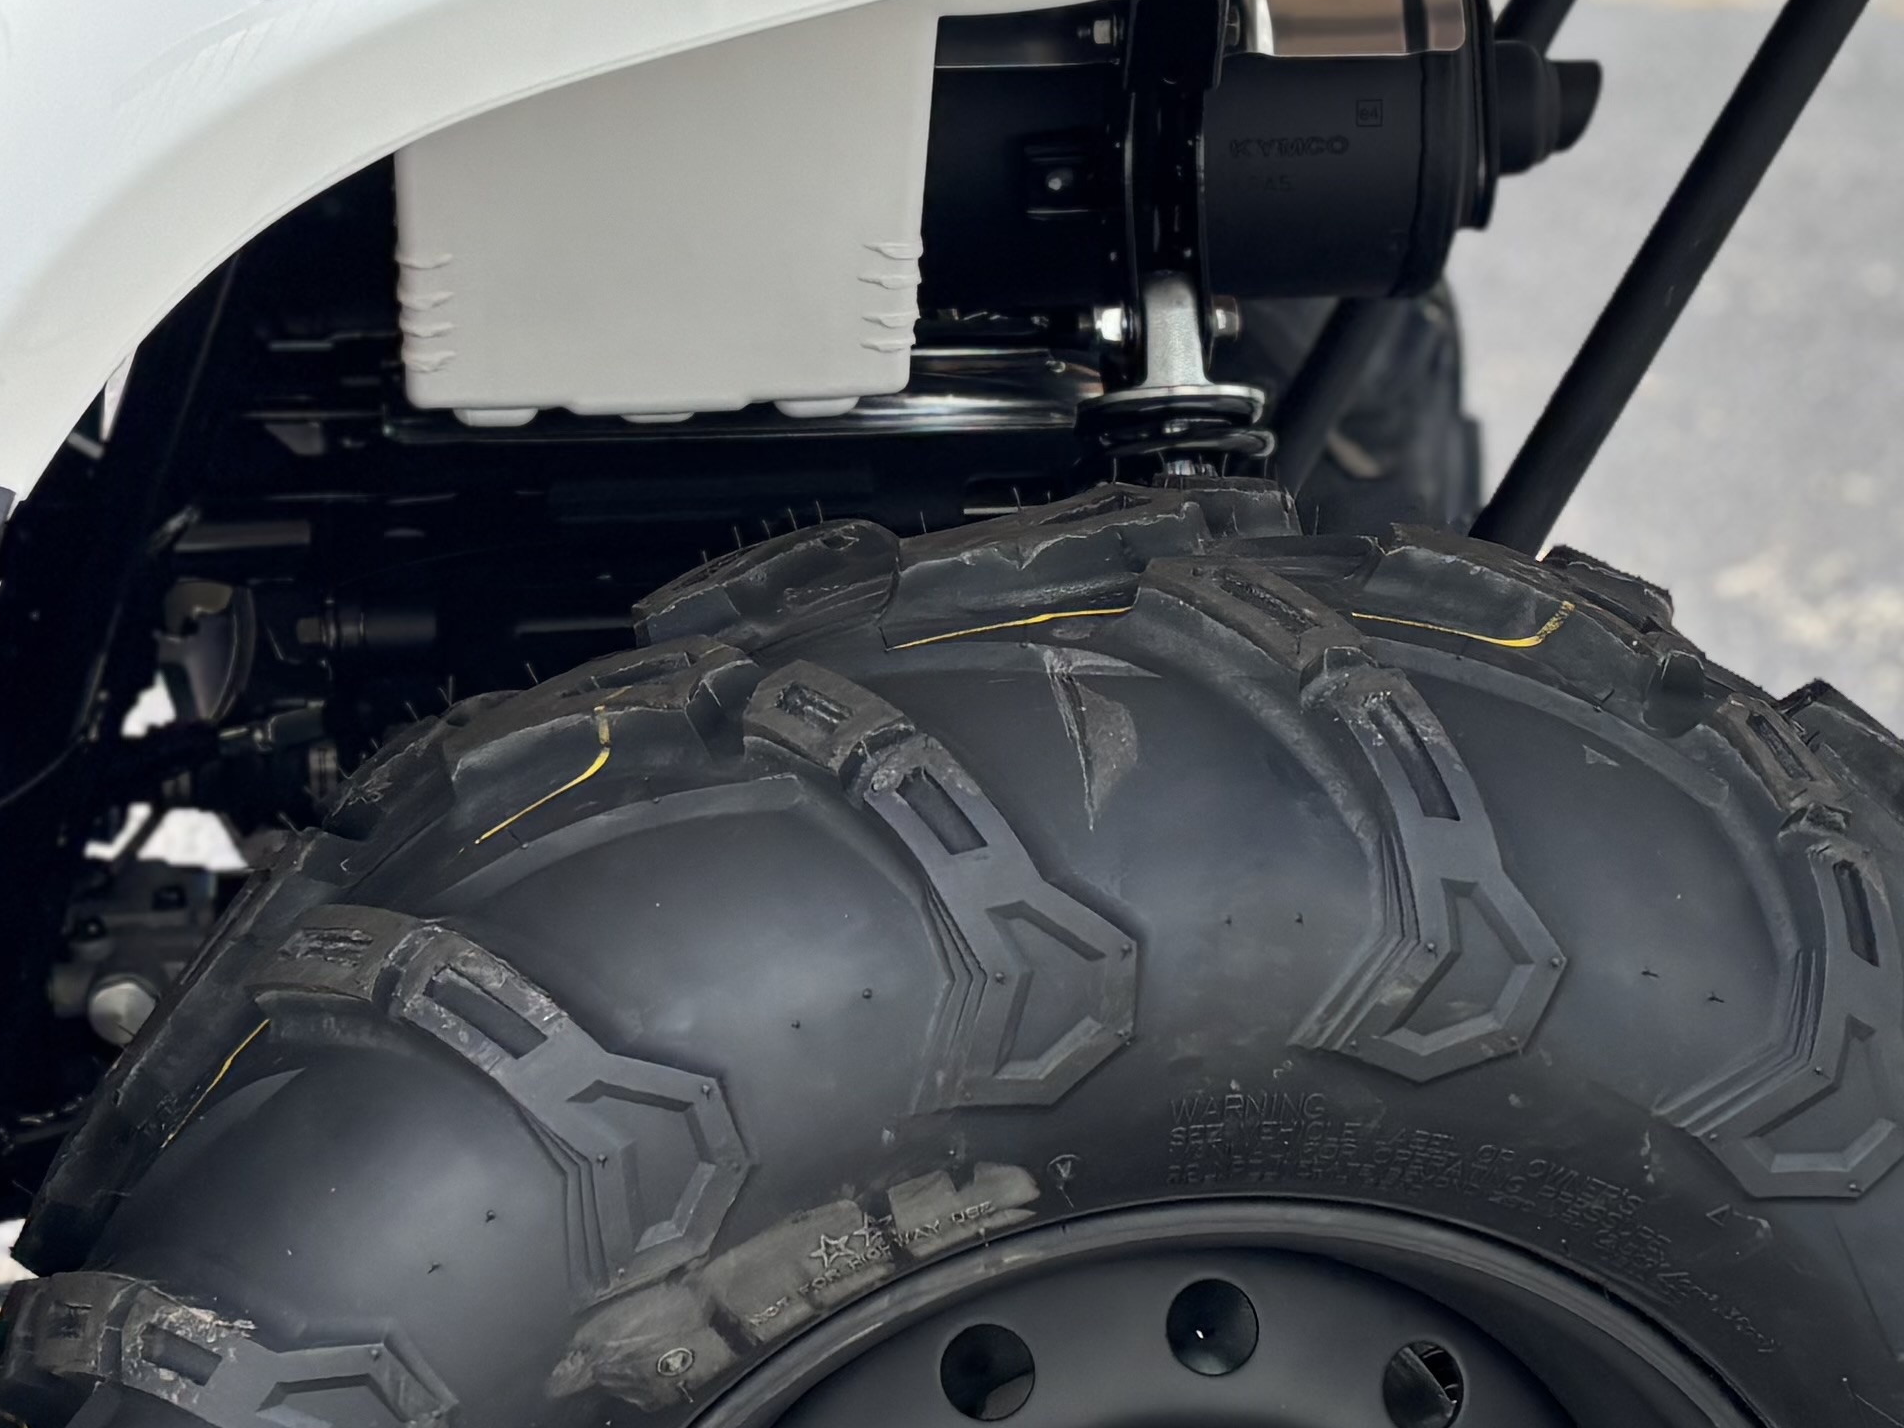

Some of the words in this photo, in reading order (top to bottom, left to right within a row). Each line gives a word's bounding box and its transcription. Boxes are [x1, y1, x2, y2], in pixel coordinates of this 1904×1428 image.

[1229, 134, 1350, 159] KYMCO
[1169, 1091, 1326, 1123] WARNING
[797, 1266, 843, 1297] FOR
